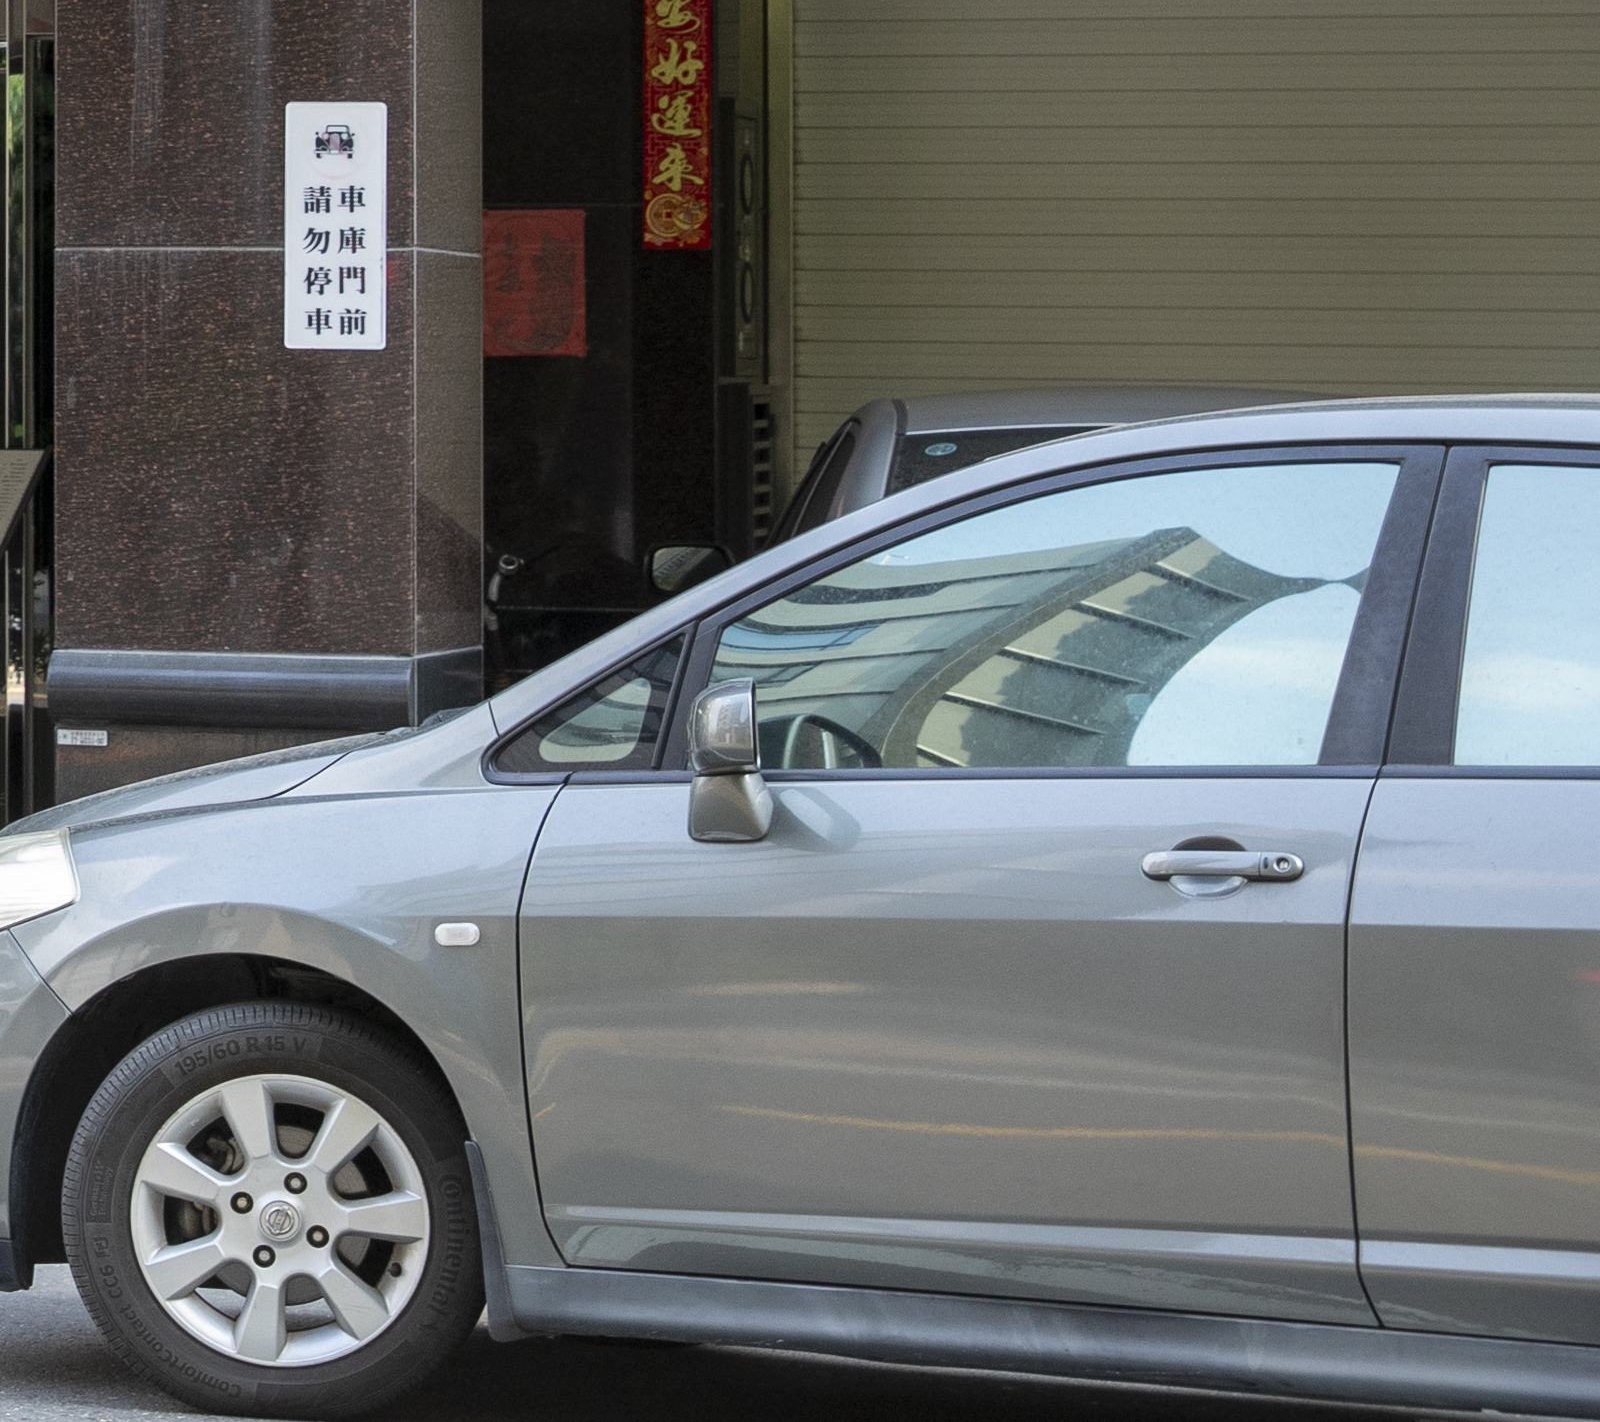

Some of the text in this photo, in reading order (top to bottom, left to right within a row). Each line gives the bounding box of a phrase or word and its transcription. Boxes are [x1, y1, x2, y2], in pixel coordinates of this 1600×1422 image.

[303, 185, 333, 336] 請勿停車
[337, 185, 367, 336] 車庫門前
[174, 1039, 241, 1078] 195/60
